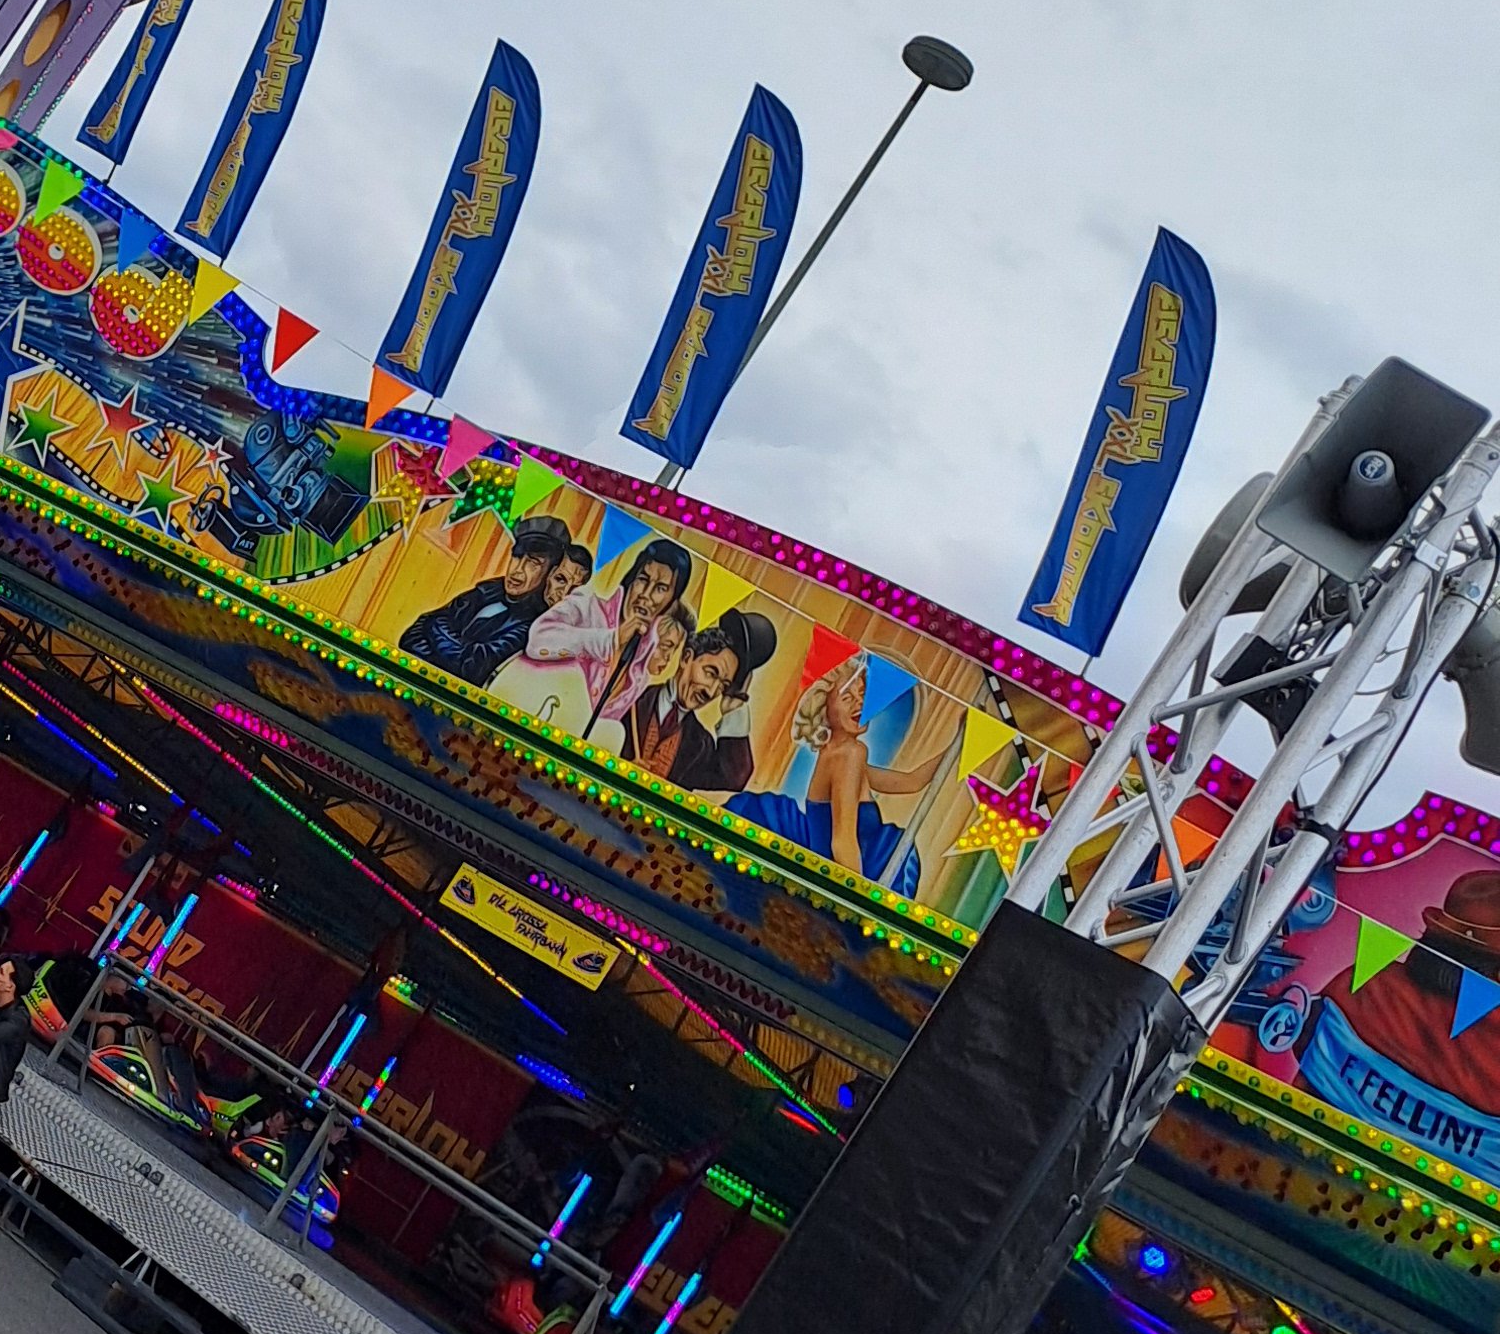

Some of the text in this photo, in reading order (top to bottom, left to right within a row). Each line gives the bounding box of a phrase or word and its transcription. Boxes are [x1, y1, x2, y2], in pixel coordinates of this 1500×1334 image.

[444, 189, 476, 245] XXL
[702, 244, 734, 301] XXL
[1120, 281, 1187, 462] EISERLOH
[1096, 406, 1142, 475] XXL
[1364, 456, 1384, 477] RCF
